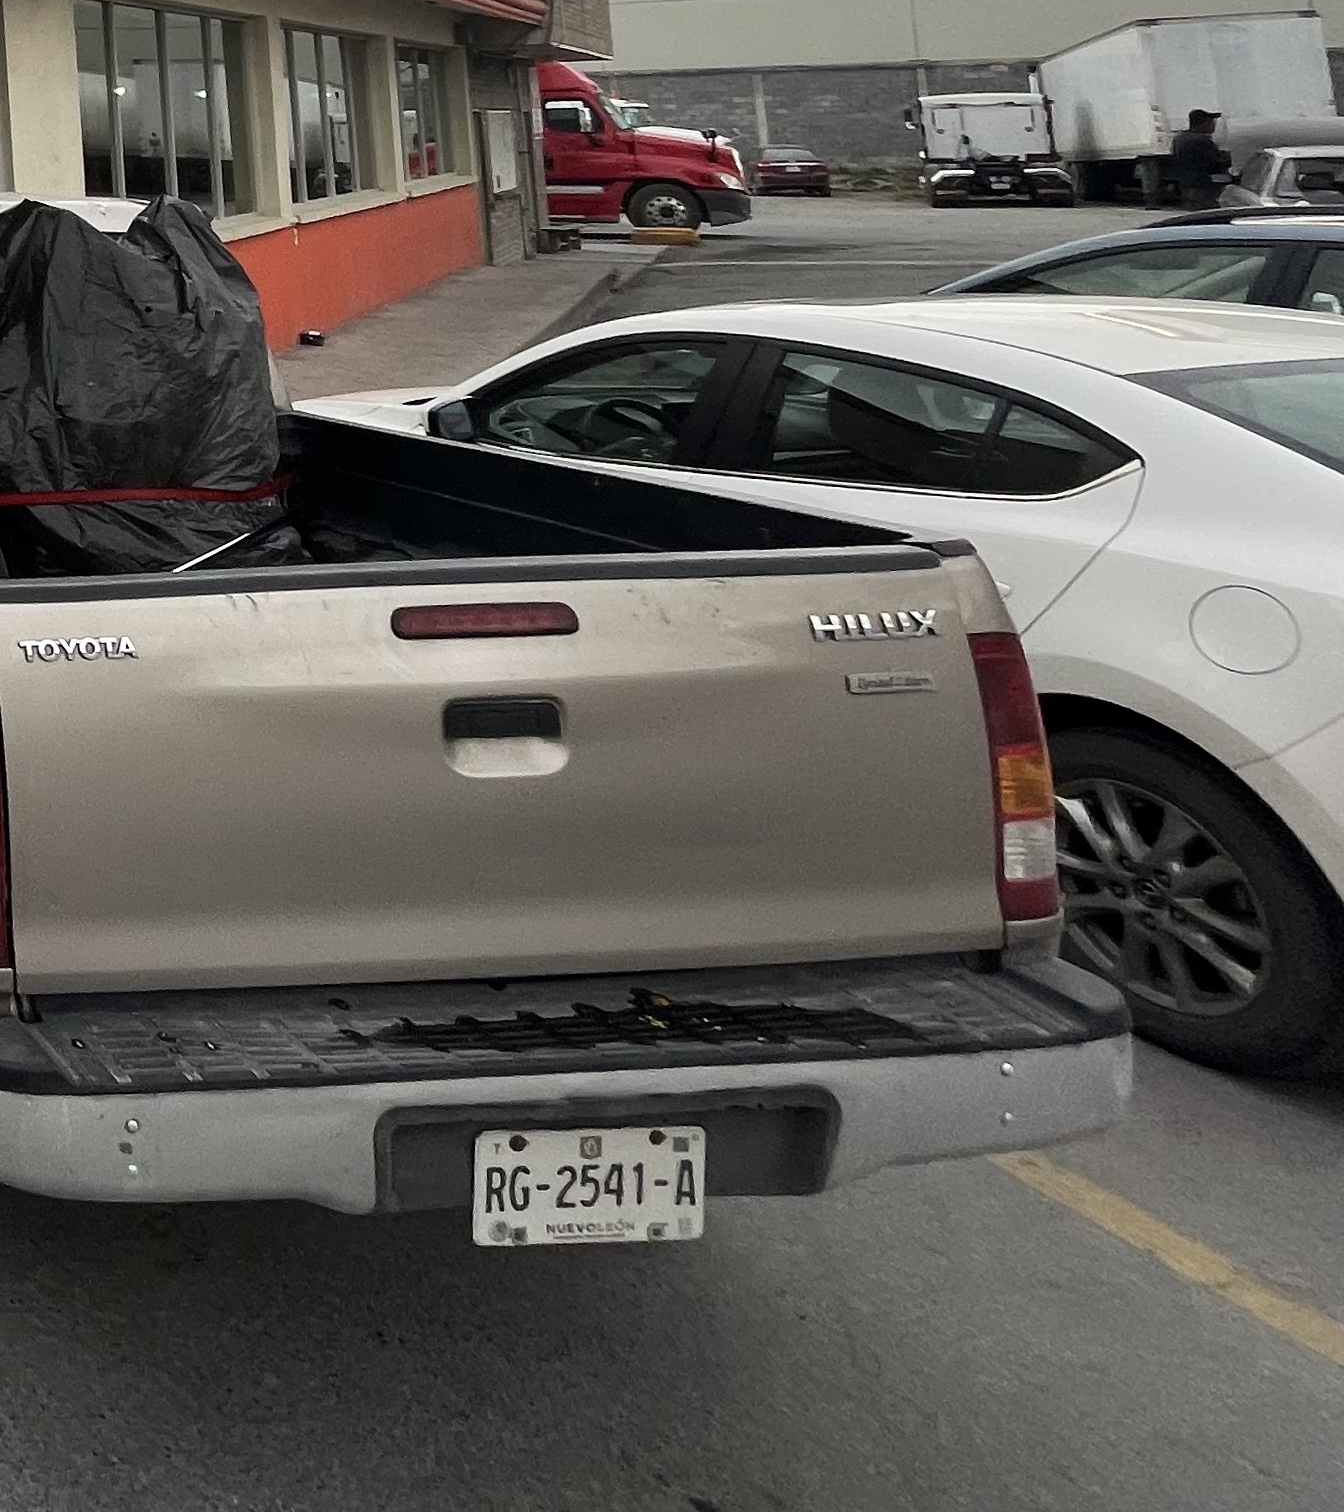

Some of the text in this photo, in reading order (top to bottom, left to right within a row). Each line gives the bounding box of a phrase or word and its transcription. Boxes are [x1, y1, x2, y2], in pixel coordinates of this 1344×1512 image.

[808, 609, 939, 642] HILUX
[17, 635, 140, 664] TOYOTA
[485, 1159, 697, 1214] RG-2541-A
